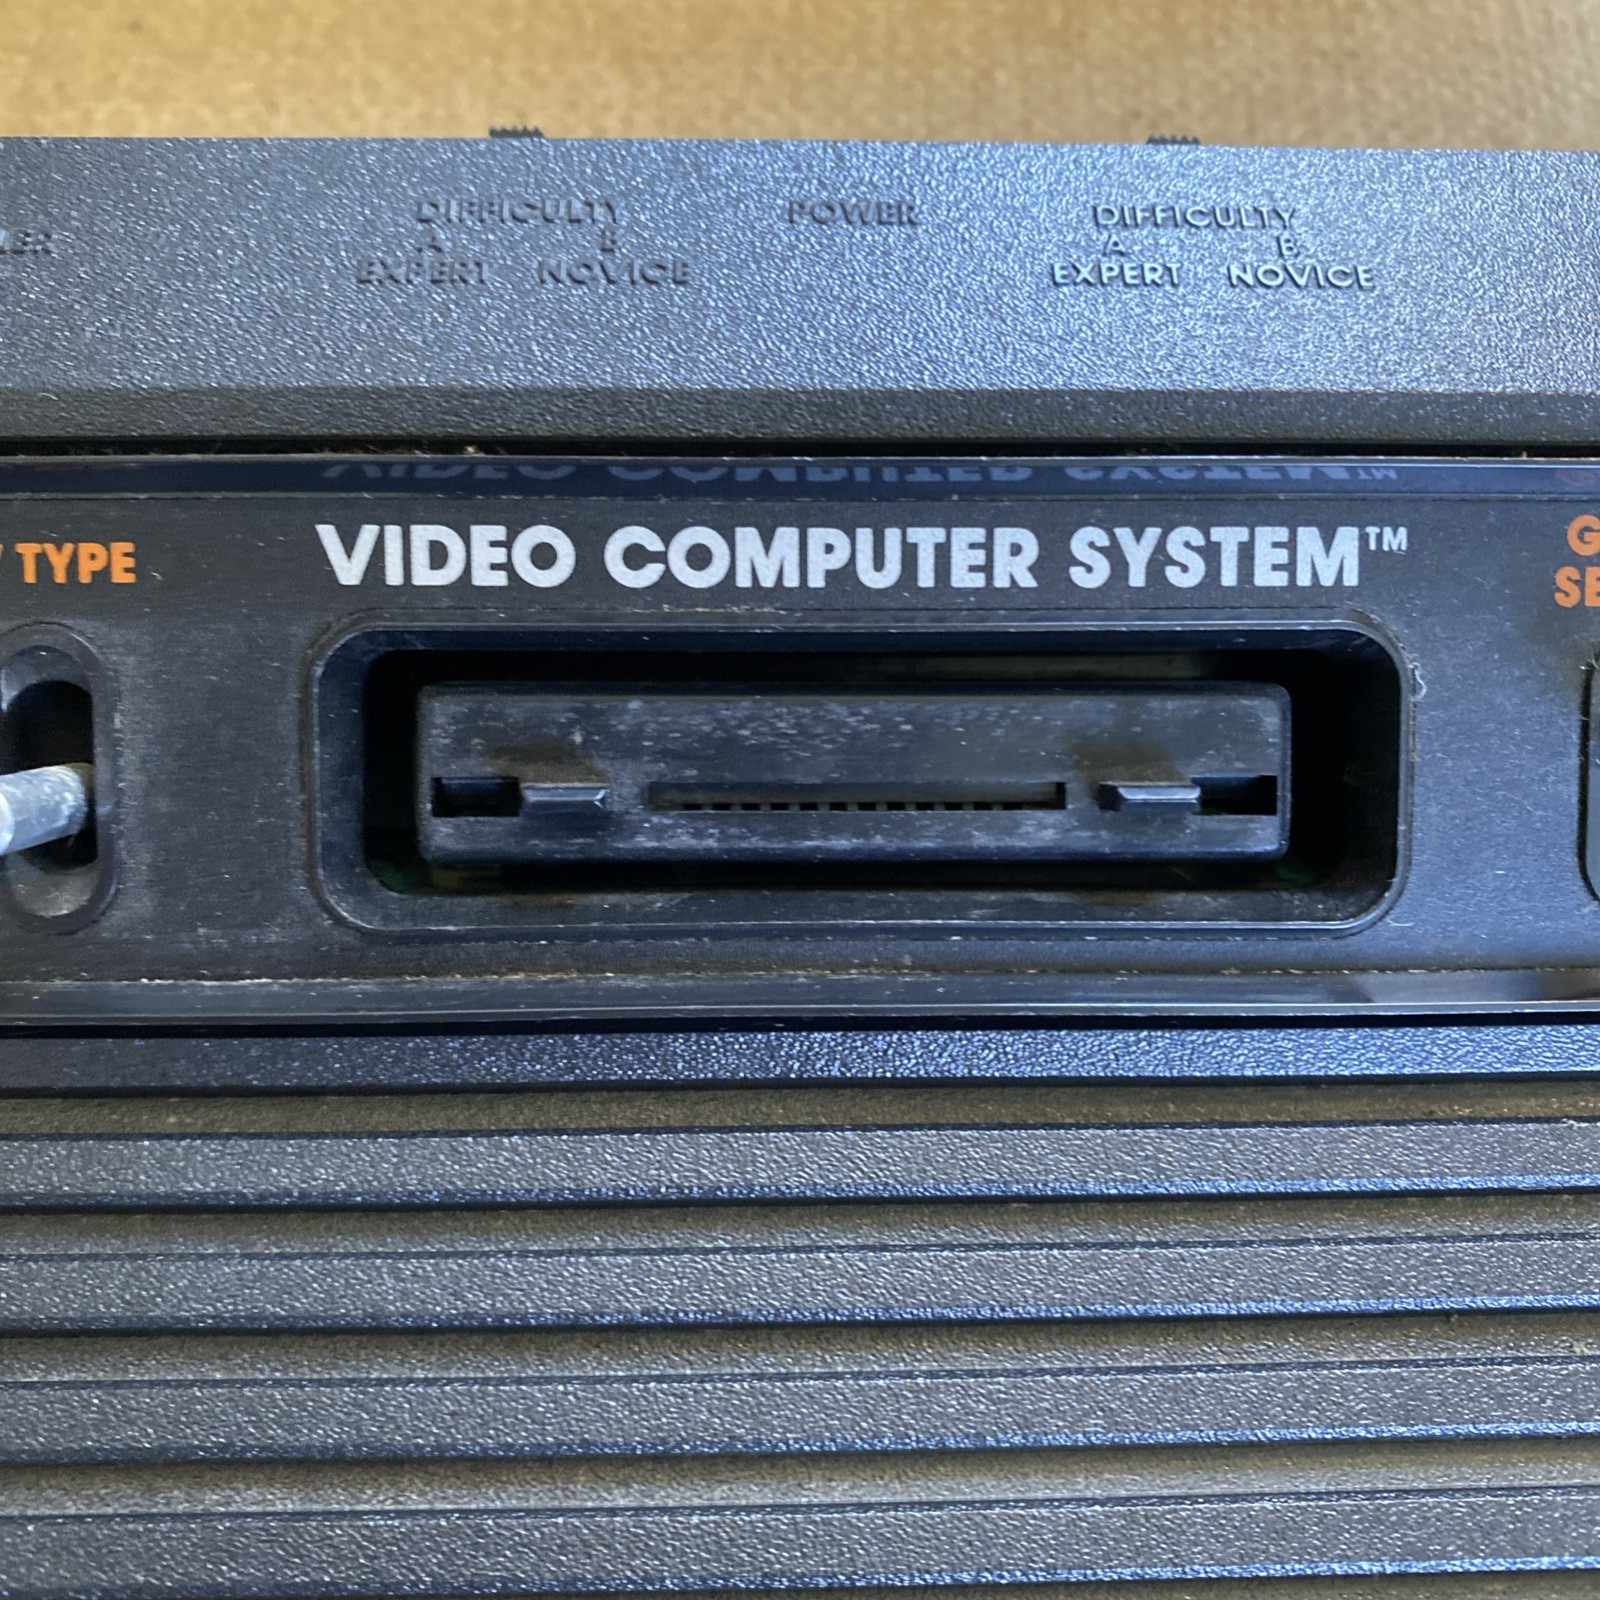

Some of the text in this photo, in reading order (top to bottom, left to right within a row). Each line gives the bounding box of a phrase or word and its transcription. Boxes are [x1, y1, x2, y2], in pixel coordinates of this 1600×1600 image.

[416, 199, 619, 224] DIFFICULTY
[788, 200, 918, 226] POWER
[1093, 205, 1294, 229] DIFFICULTY
[1103, 234, 1300, 259] A B
[356, 258, 691, 286] EXPERT NOVICE
[1051, 262, 1376, 290] EXPERT NOVICE
[14, 541, 137, 584] TYPE
[315, 524, 577, 588] VIDEO
[603, 525, 1040, 590] COMPUTER
